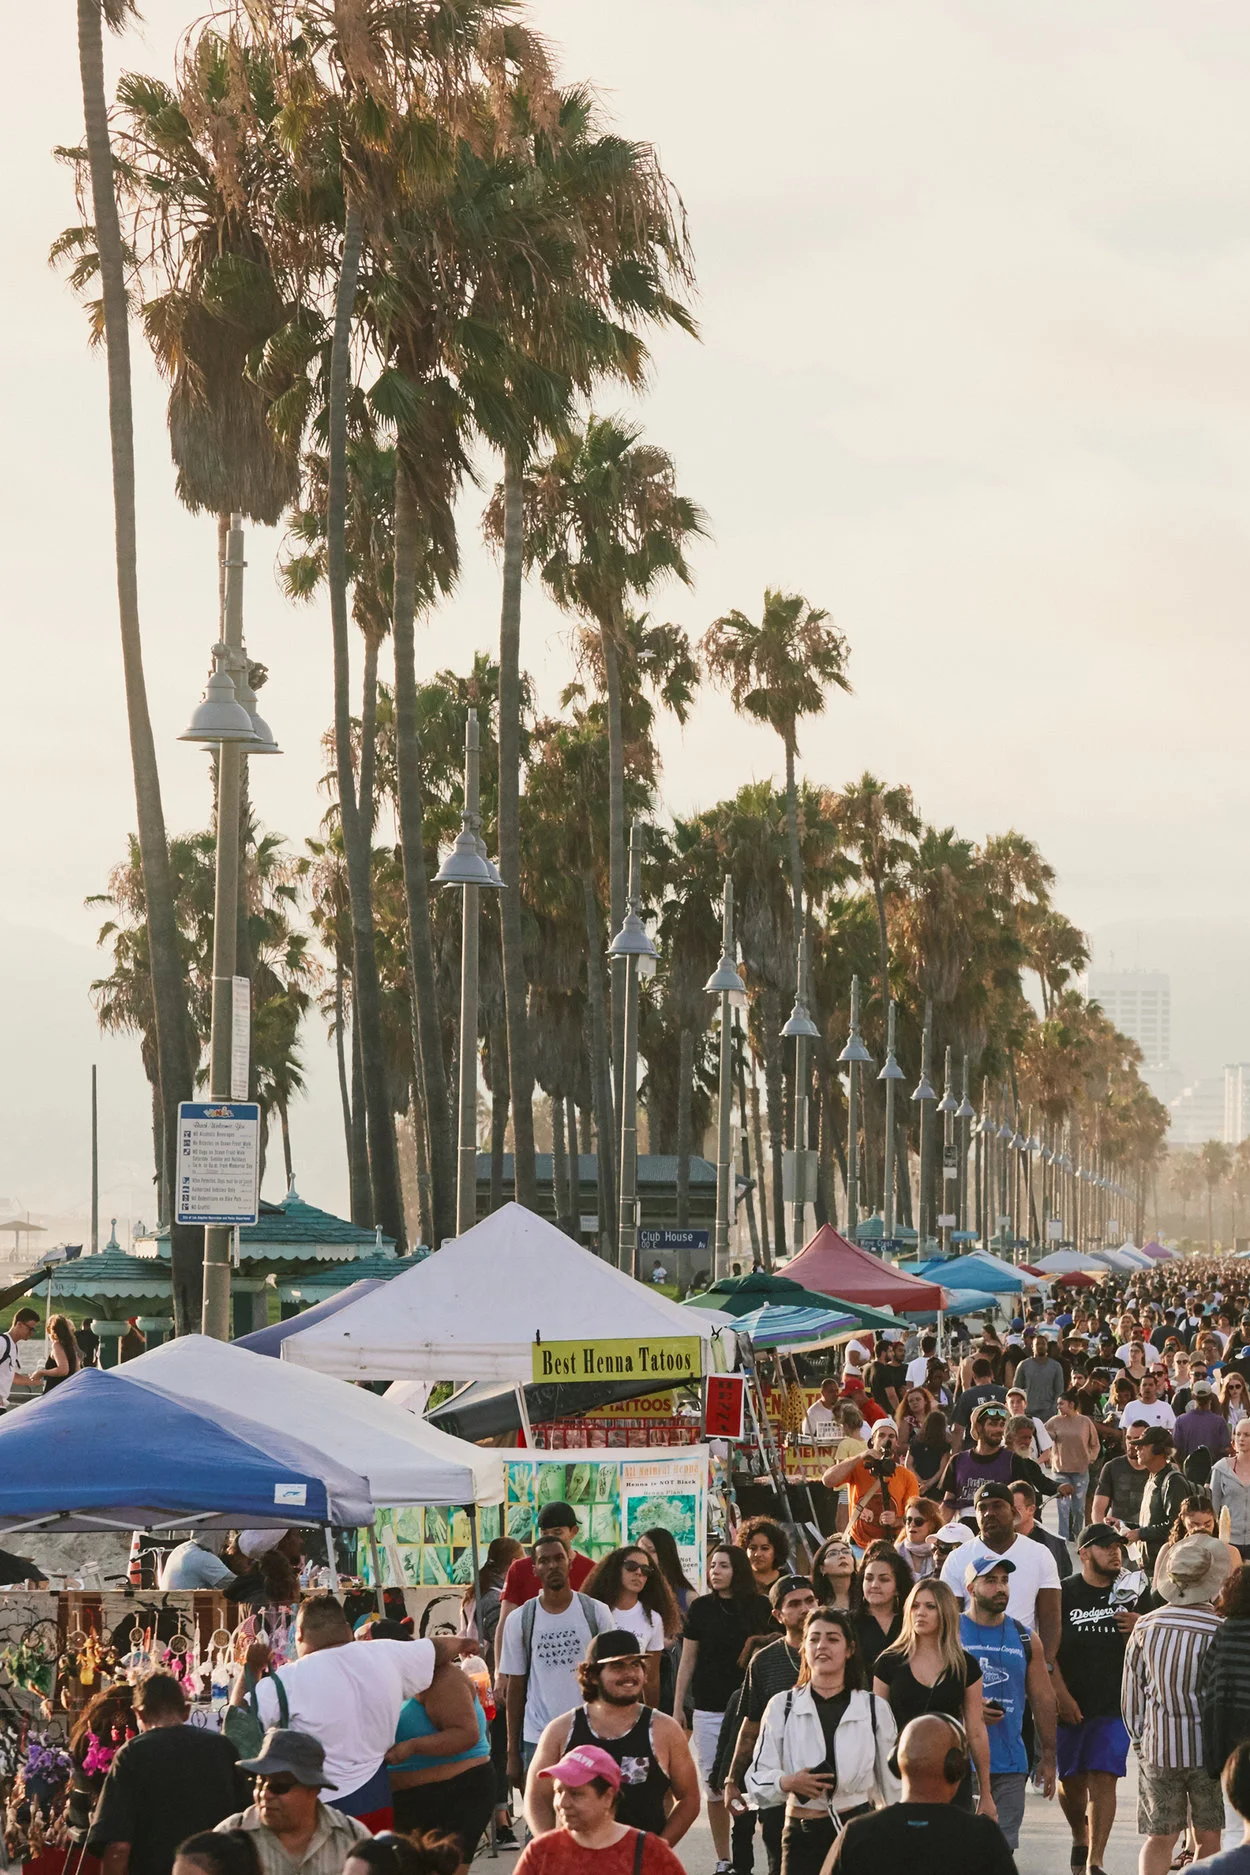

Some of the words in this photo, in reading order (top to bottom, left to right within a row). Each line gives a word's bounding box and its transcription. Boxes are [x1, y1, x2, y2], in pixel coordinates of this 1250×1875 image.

[641, 1231, 660, 1242] Club
[664, 1231, 693, 1242] House
[542, 1350, 577, 1376] Best
[583, 1348, 634, 1374] Henna
[638, 1346, 691, 1372] Tatoos
[624, 1466, 636, 1478] All
[639, 1464, 671, 1476] Natural
[673, 1462, 699, 1475] Henna
[786, 1464, 830, 1476] TATTO
[1069, 1606, 1117, 1626] Dodgers
[1077, 1625, 1116, 1633] BASEBA
